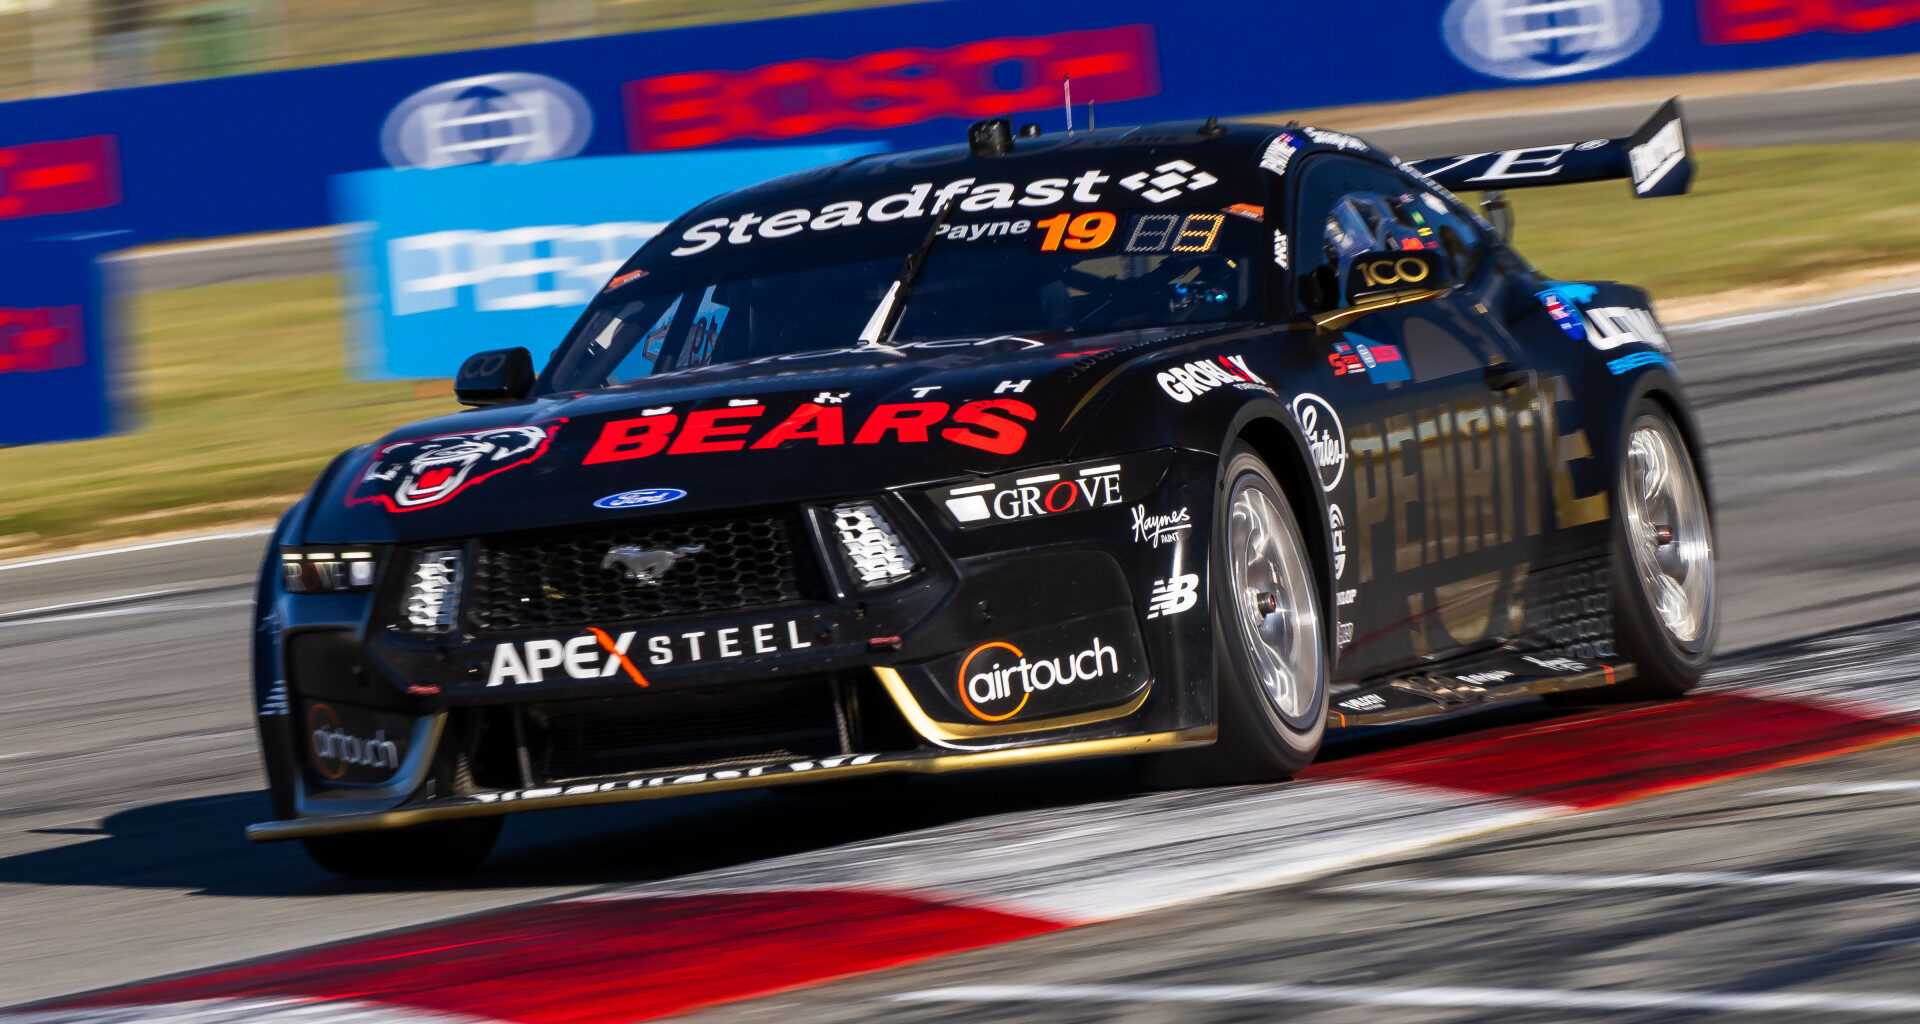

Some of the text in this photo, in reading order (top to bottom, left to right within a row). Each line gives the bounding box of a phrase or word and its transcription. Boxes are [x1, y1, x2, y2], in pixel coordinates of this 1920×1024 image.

[671, 170, 1110, 257] Steadfast
[936, 211, 1117, 252] Payne 19
[581, 398, 1038, 466] BEARS
[993, 473, 1123, 520] GROVE
[1131, 503, 1191, 548] Haymes
[1160, 531, 1181, 544] PAINT
[486, 619, 812, 688] APEX STEEL
[968, 636, 1118, 704] airtouch
